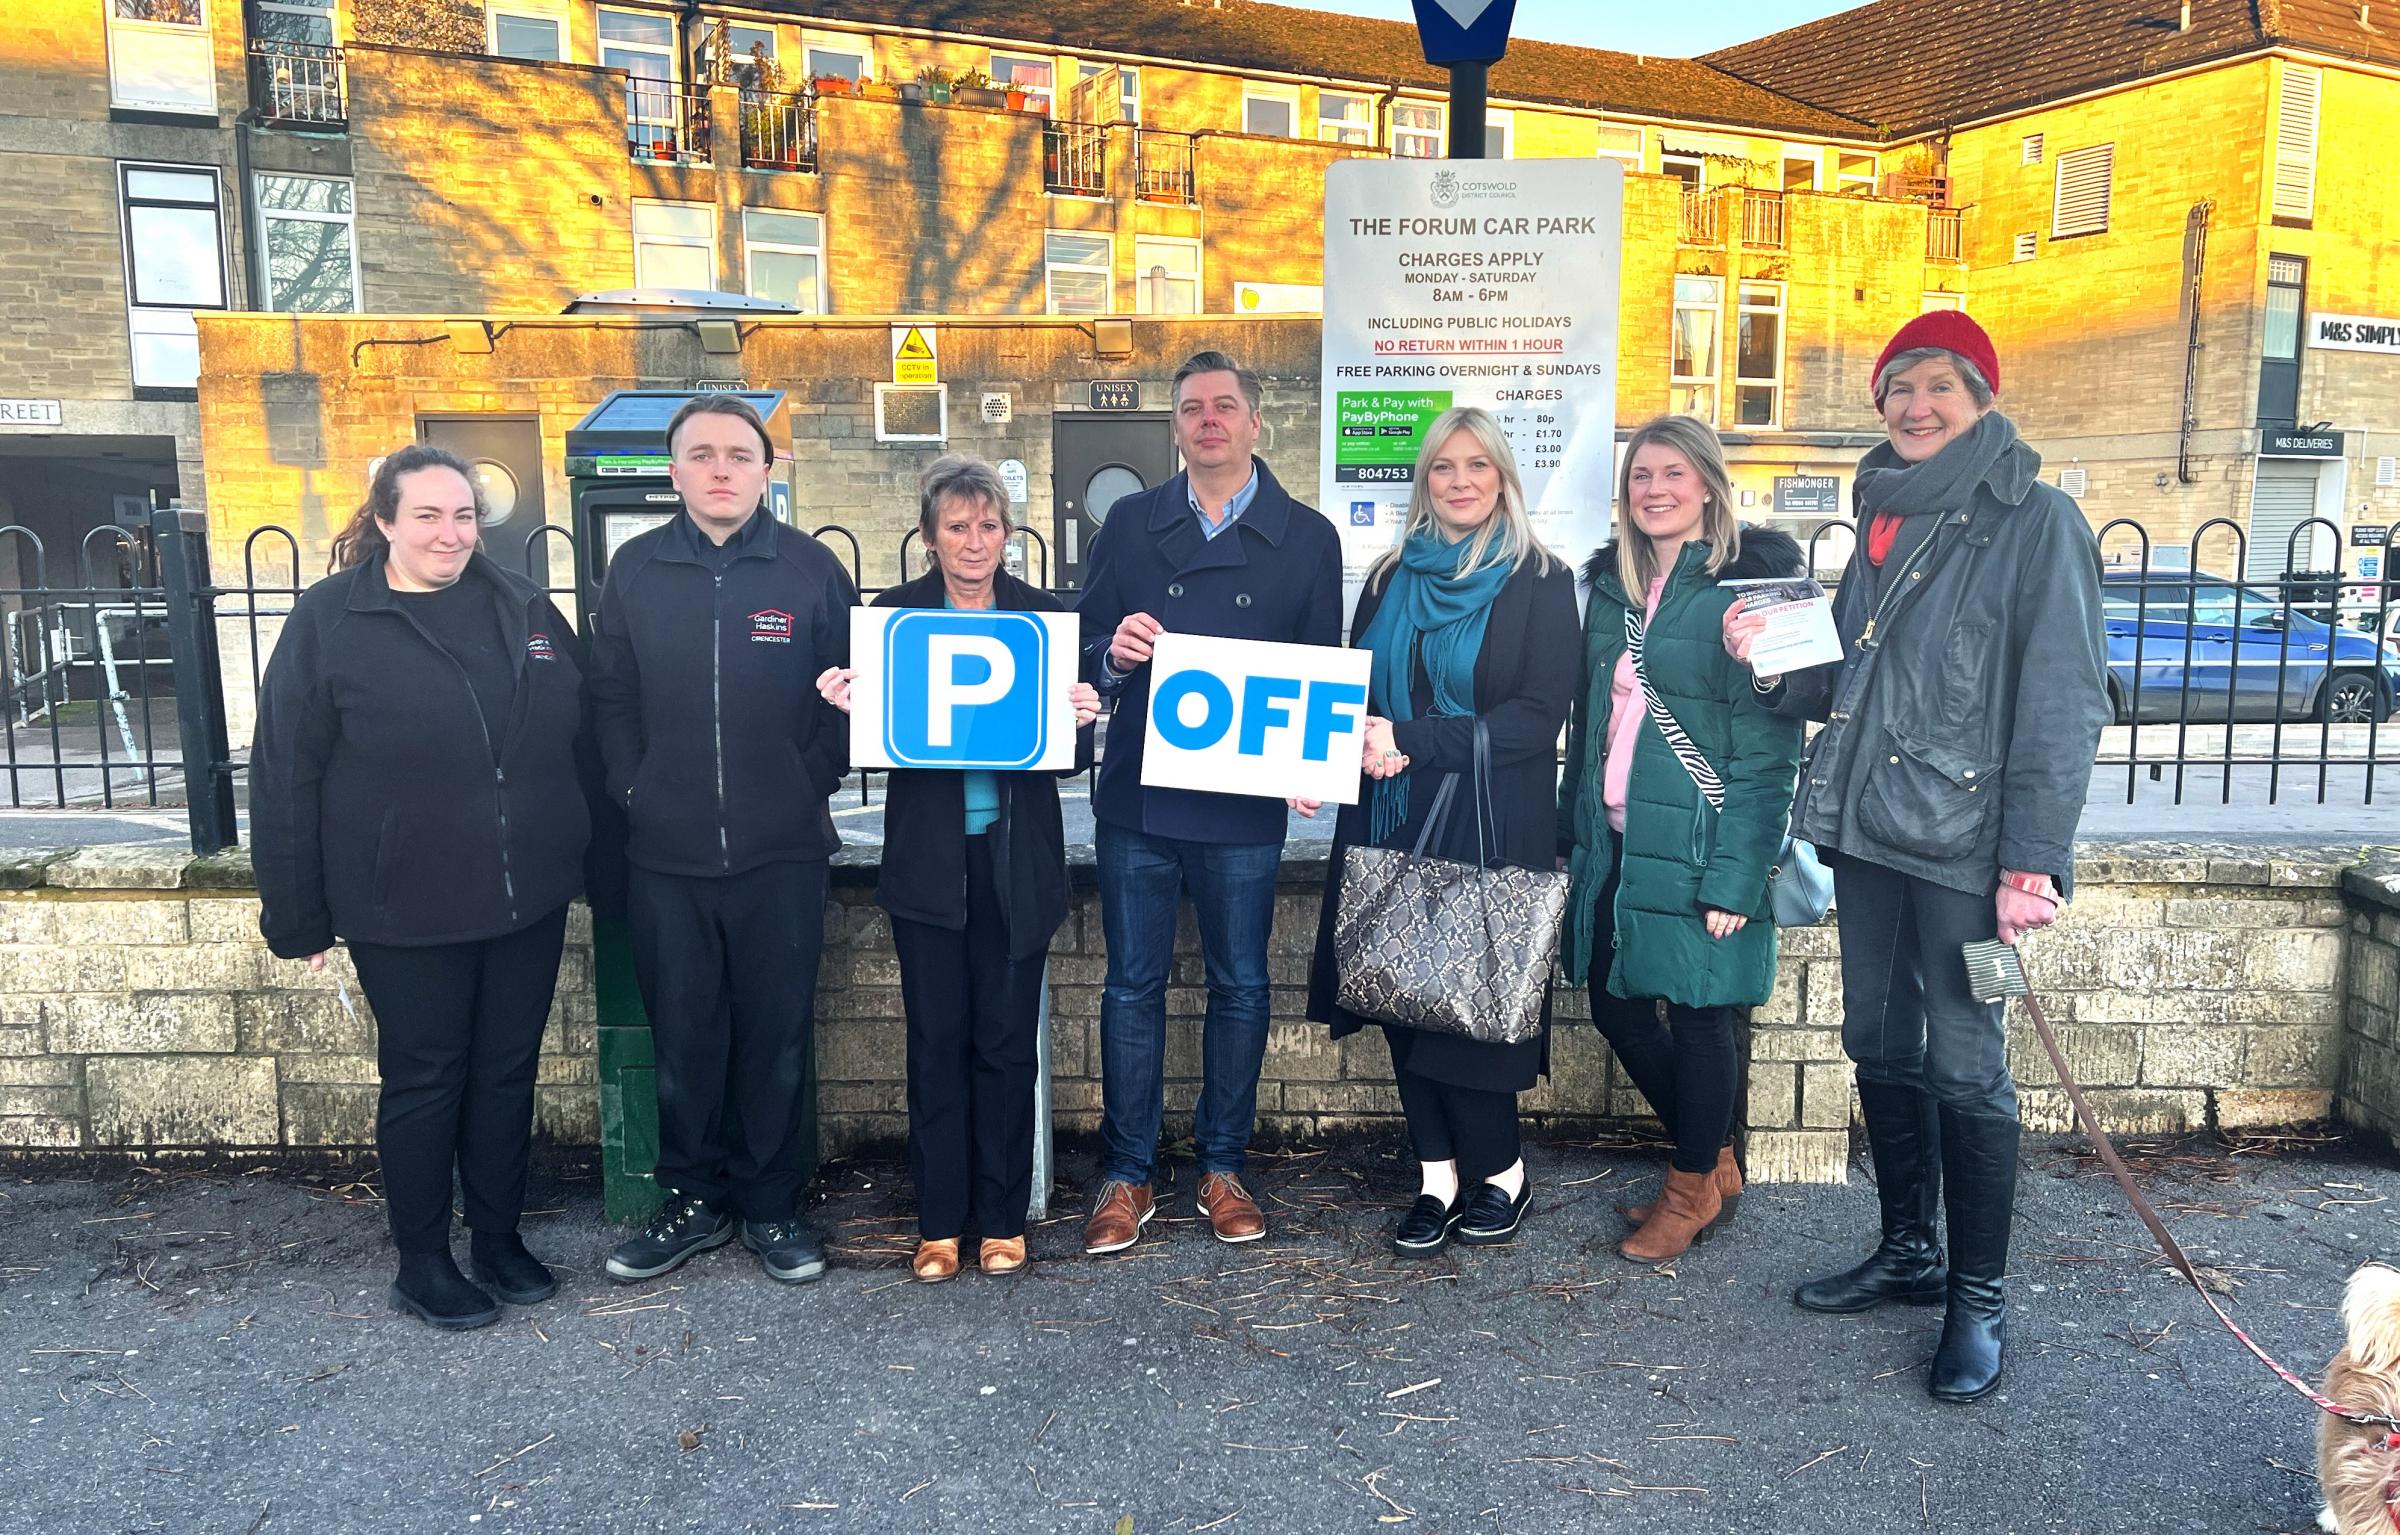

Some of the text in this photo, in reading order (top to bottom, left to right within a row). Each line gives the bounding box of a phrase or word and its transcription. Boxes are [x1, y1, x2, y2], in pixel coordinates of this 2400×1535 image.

[1462, 182, 1517, 191] COTSWOLD
[1349, 216, 1597, 236] THE FORUM CAR PARK
[1398, 252, 1544, 267] CHARGES APPLY
[1404, 273, 1459, 284] MONDAY
[1468, 272, 1537, 284] SATURDAY
[1432, 288, 1463, 302] 8AM
[1478, 288, 1508, 302] 6PM
[1368, 316, 1572, 329] INCLUDING PUBLIC HOLIDAYS
[2320, 321, 2353, 342] M&S
[1374, 338, 1564, 352] NO RETURN WITHIN 1 HOUR
[1336, 364, 1601, 377] FREE PARKING OVERNIGHT & SUNDAYS
[1096, 384, 1133, 392] UNISEX
[1496, 390, 1563, 401] CHARGES
[1343, 397, 1434, 410] Park & Pay with
[0, 403, 56, 420] REET
[1343, 411, 1419, 424] PayByPhone
[1504, 415, 1514, 424] hr
[1536, 414, 1555, 425] 80p
[1536, 429, 1562, 438] £1.70
[1535, 444, 1562, 454] £3.00
[2275, 437, 2333, 449] M&S DELIVERIES
[1535, 459, 1561, 468] £3.90
[1358, 467, 1408, 479] 804753
[1779, 478, 1834, 489] FISHMONGER
[1744, 597, 1771, 609] HARGES
[1762, 607, 1778, 617] OUR
[1779, 601, 1814, 612] PETITION
[754, 615, 788, 624] Gardiner
[755, 622, 787, 631] Haskins
[927, 632, 1016, 748] P
[1152, 668, 1366, 762] OFF
